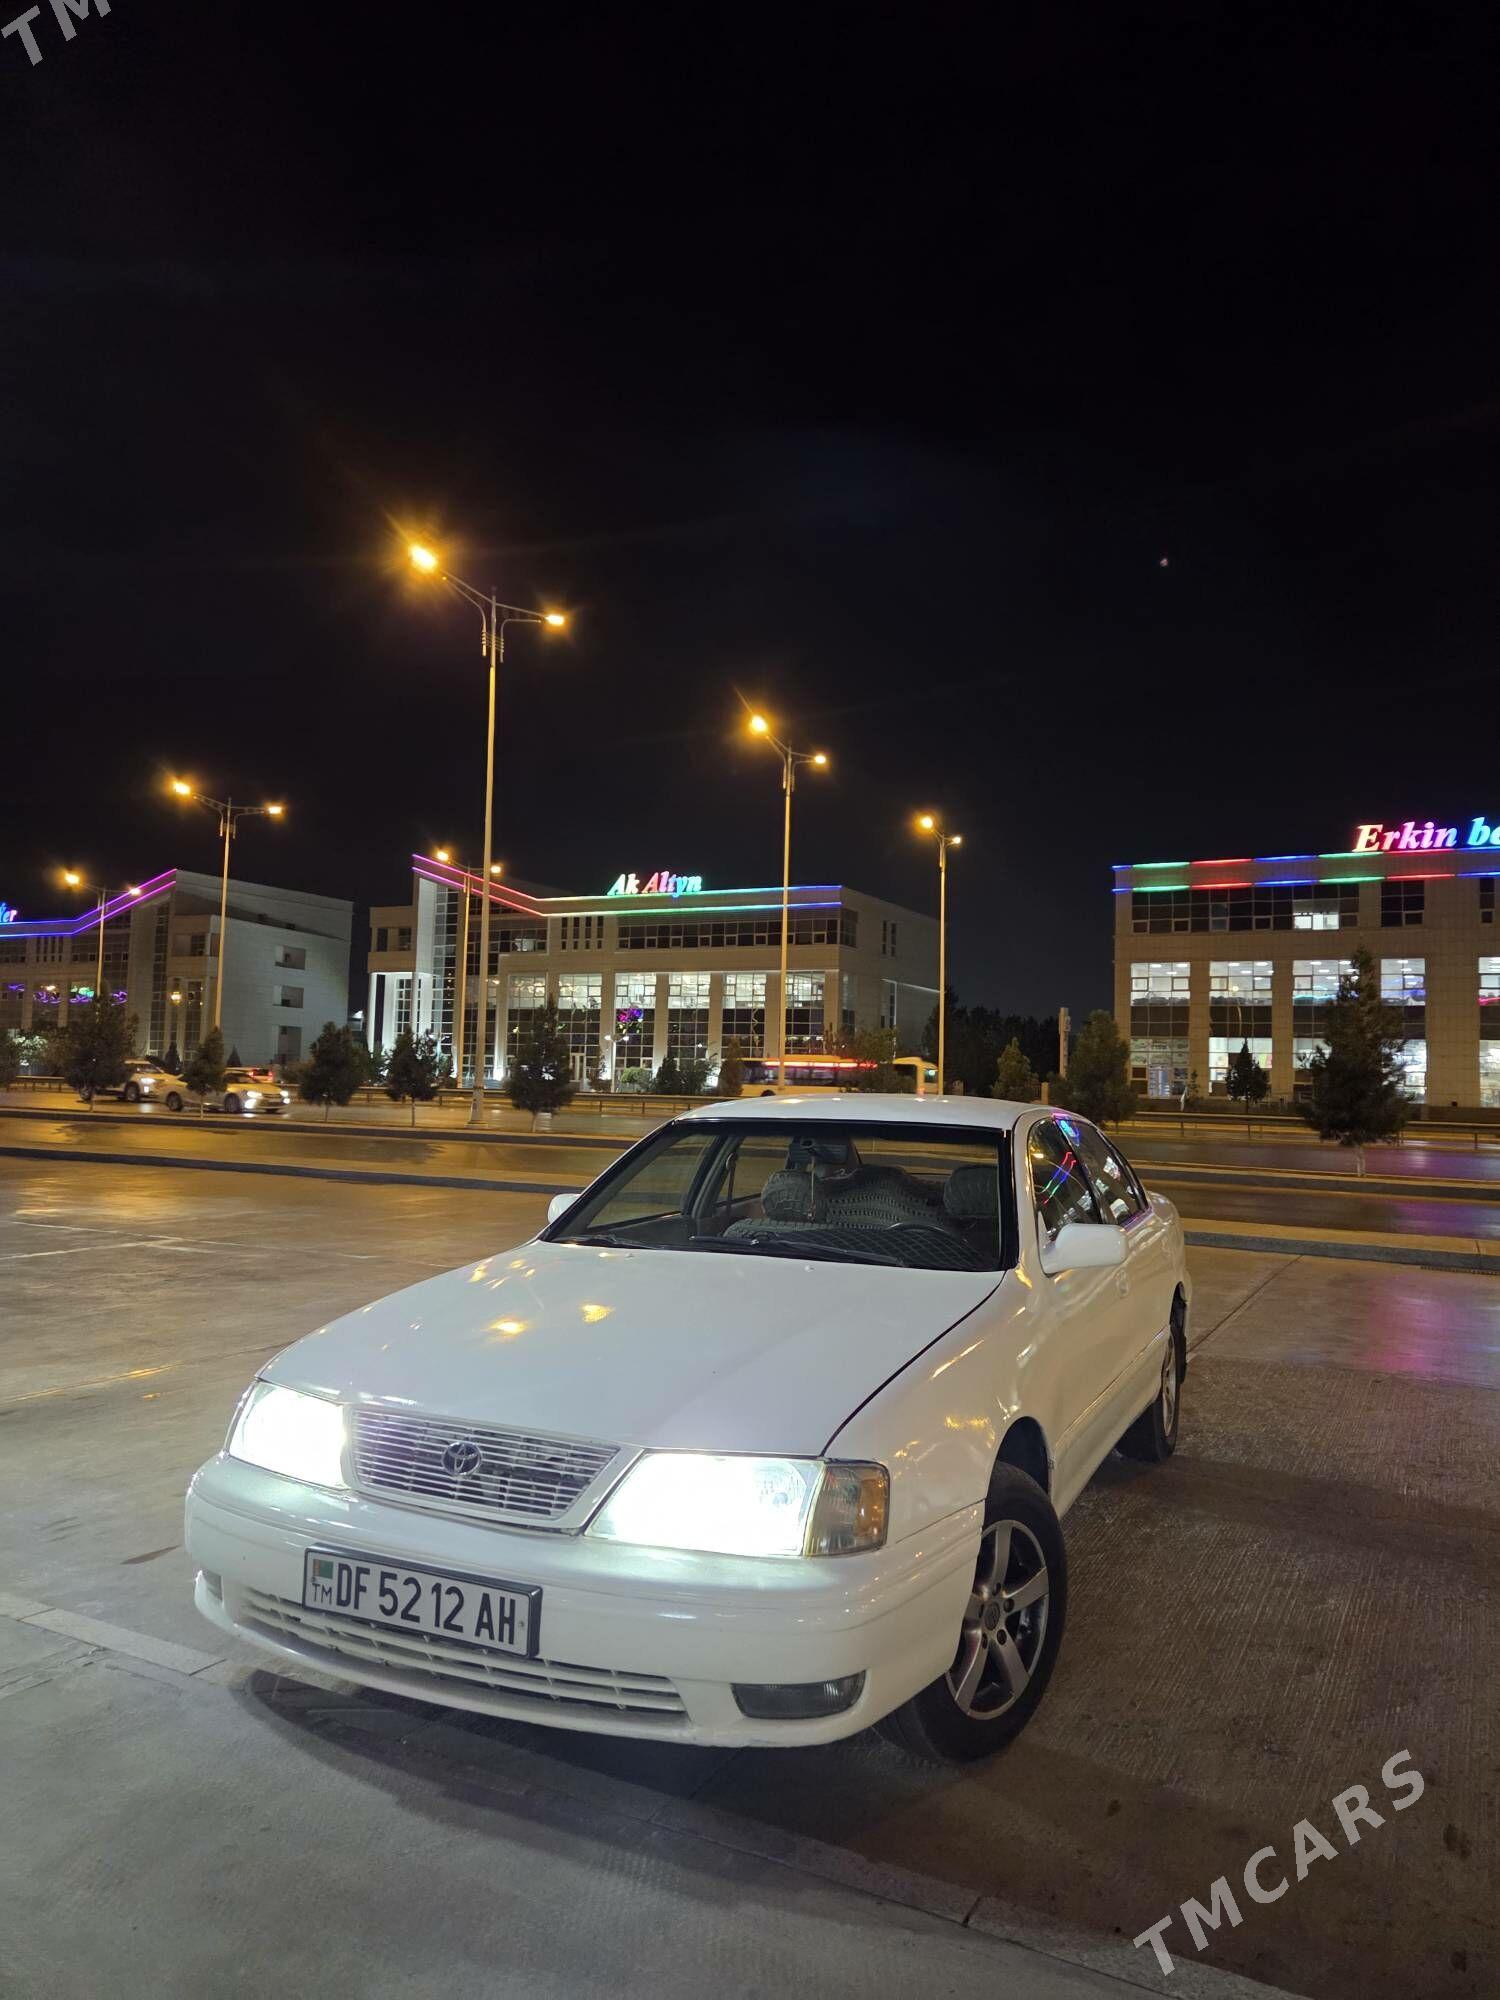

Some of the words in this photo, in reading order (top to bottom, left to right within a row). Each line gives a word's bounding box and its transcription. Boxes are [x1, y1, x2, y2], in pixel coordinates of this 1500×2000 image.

[1352, 822, 1458, 851] Erkin
[607, 874, 639, 896] Ak
[641, 871, 702, 898] Altyn
[312, 1582, 333, 1605] TM
[336, 1563, 370, 1610] DF
[379, 1571, 465, 1633] 5212
[475, 1593, 516, 1645] AH
